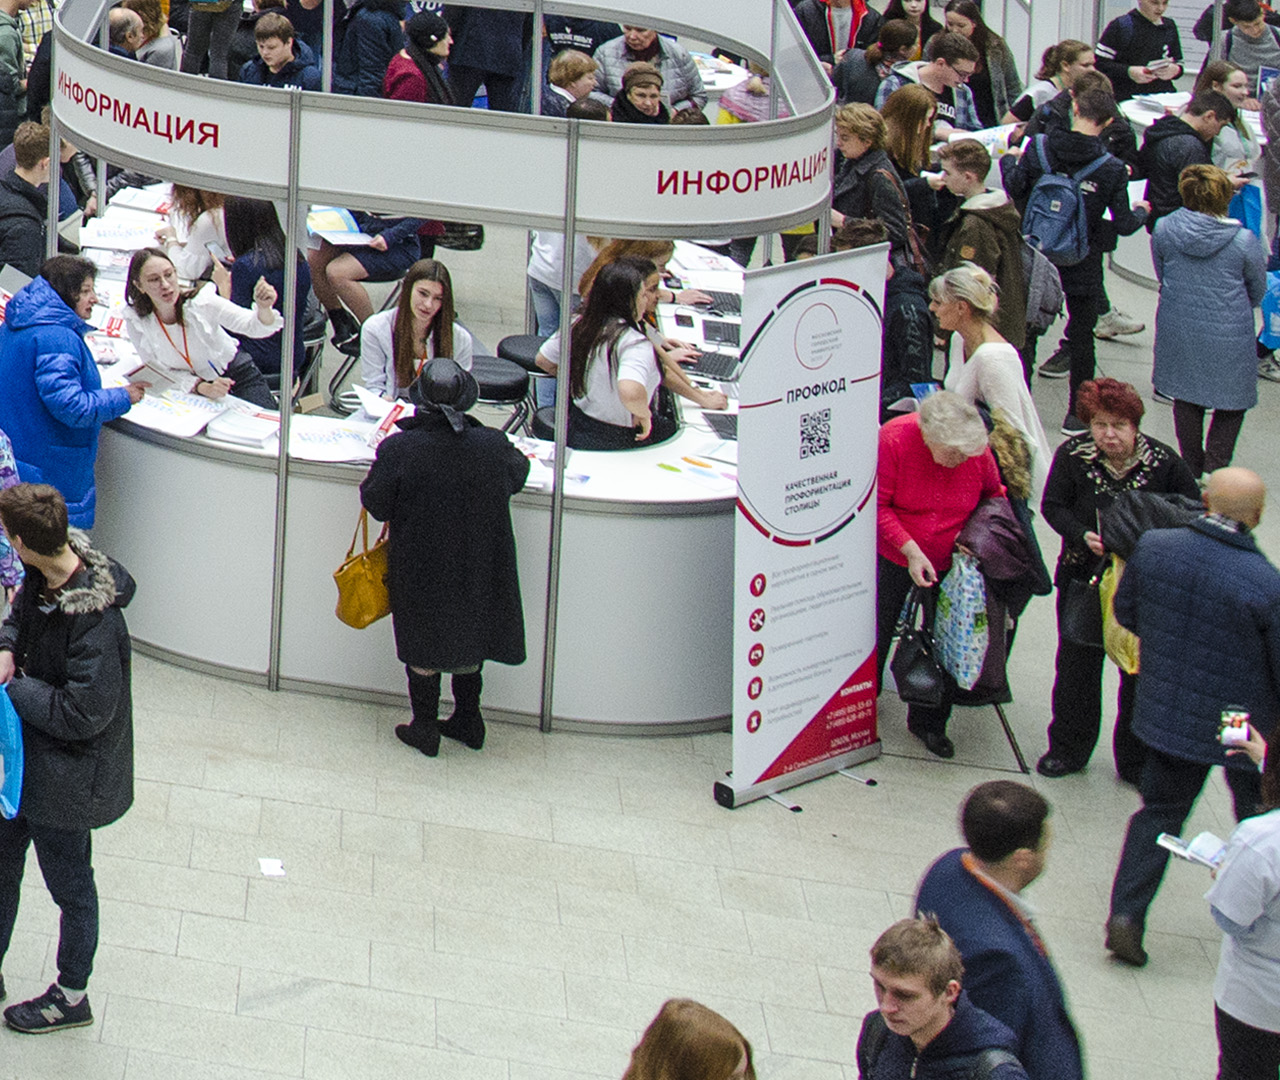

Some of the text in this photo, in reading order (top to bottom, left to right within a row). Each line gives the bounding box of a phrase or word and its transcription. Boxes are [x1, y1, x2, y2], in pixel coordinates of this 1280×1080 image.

[57, 68, 221, 150] ИНФОРМАЦИЯ
[656, 147, 830, 198] ИНФОРМАЦИЯ
[786, 377, 847, 404] ПРОФКОД
[785, 470, 838, 492] КАЧЕСТВЕННАЯ
[785, 478, 852, 504] ПРОФОРИЕНТАЦИЯ
[784, 499, 820, 516] СТОЛИЦЫ
